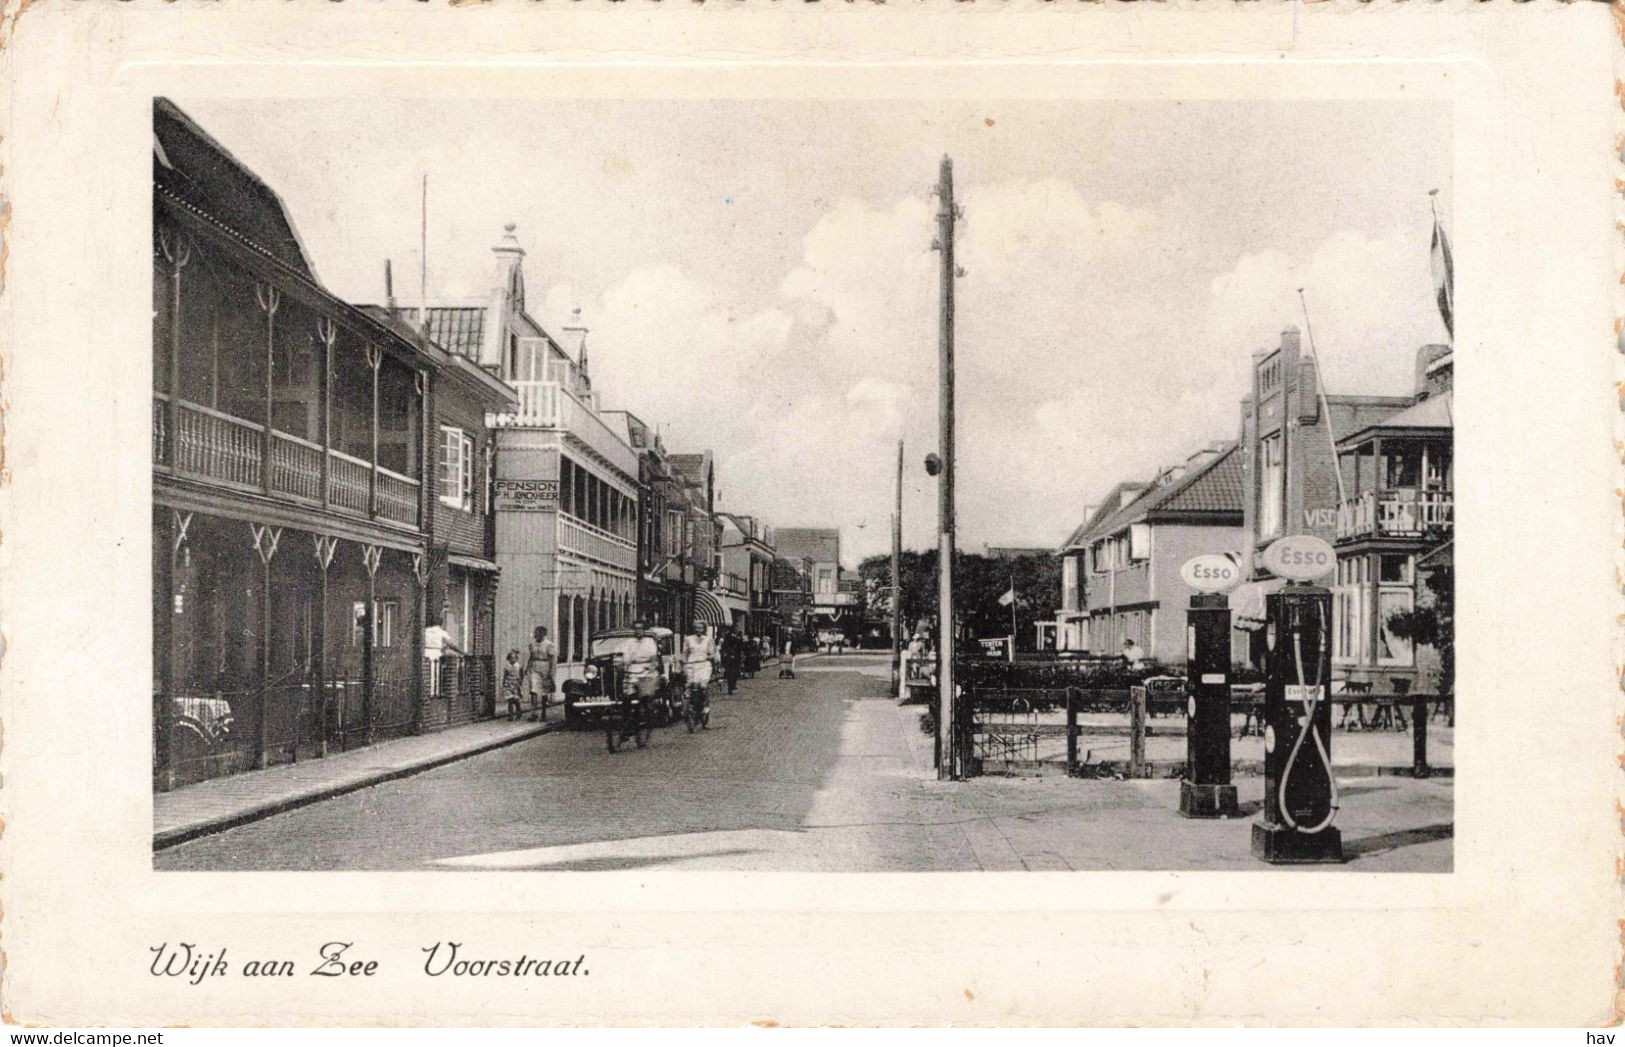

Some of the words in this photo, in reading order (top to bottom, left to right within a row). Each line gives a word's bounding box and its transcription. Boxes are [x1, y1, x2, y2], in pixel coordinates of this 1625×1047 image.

[496, 482, 557, 491] PENSION
[1280, 547, 1327, 565] Esso
[1193, 563, 1232, 579] Esso
